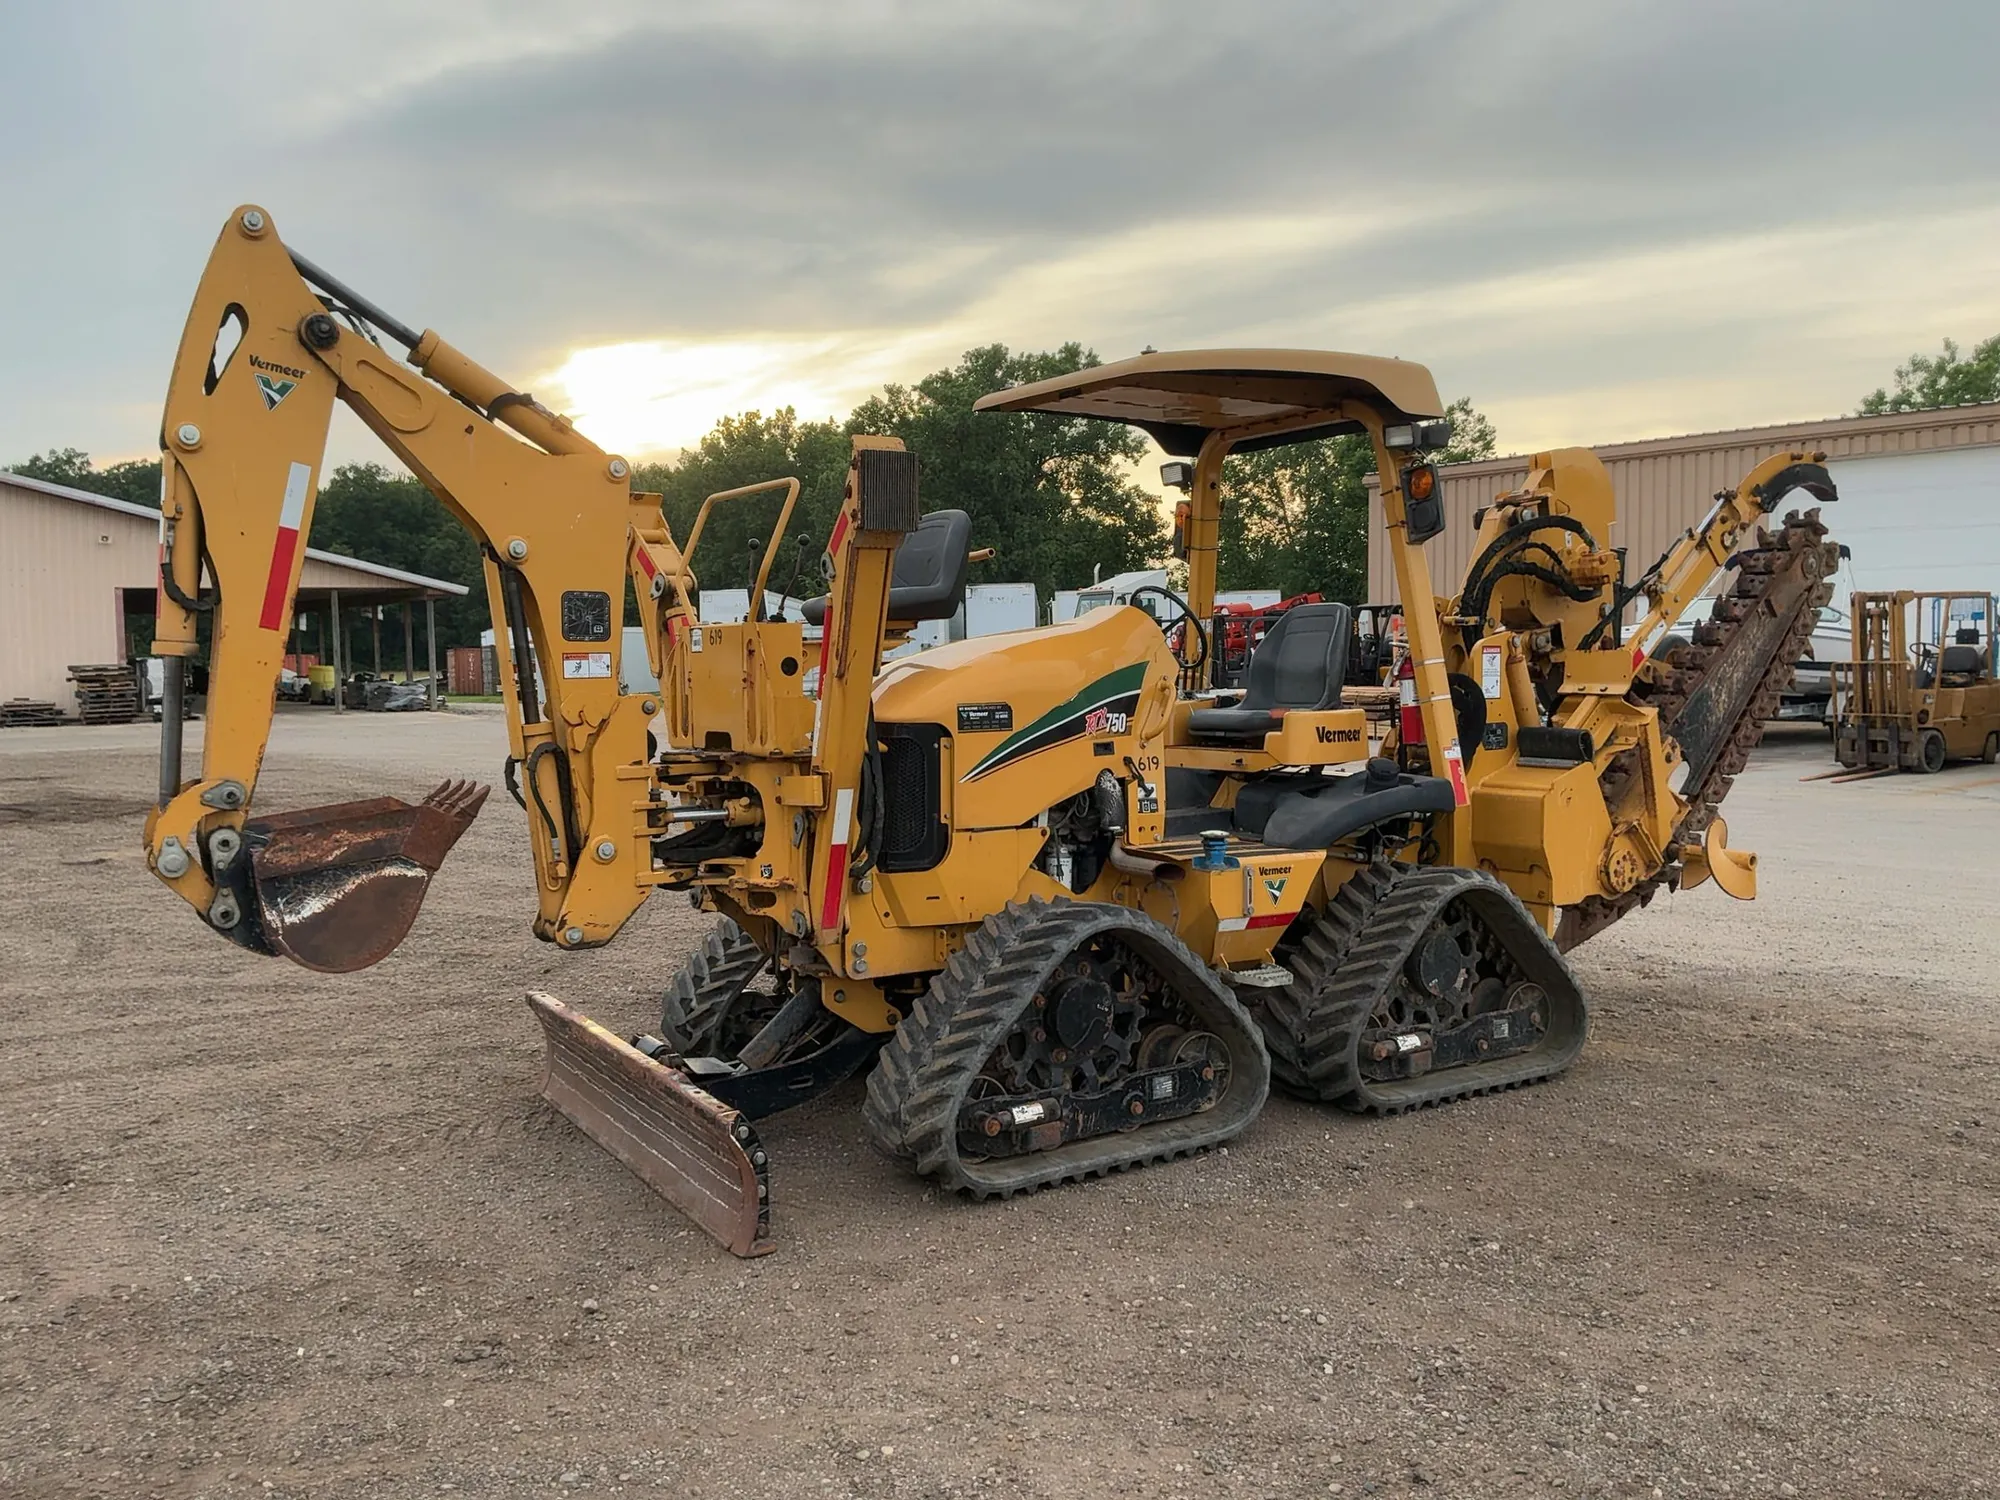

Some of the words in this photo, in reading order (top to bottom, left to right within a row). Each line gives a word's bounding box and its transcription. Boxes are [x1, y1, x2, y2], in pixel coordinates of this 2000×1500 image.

[249, 354, 306, 379] Vermeer
[709, 629, 722, 645] 619
[1315, 726, 1361, 743] Vermeer
[1138, 756, 1159, 771] 619
[1258, 866, 1291, 876] Vermeer
